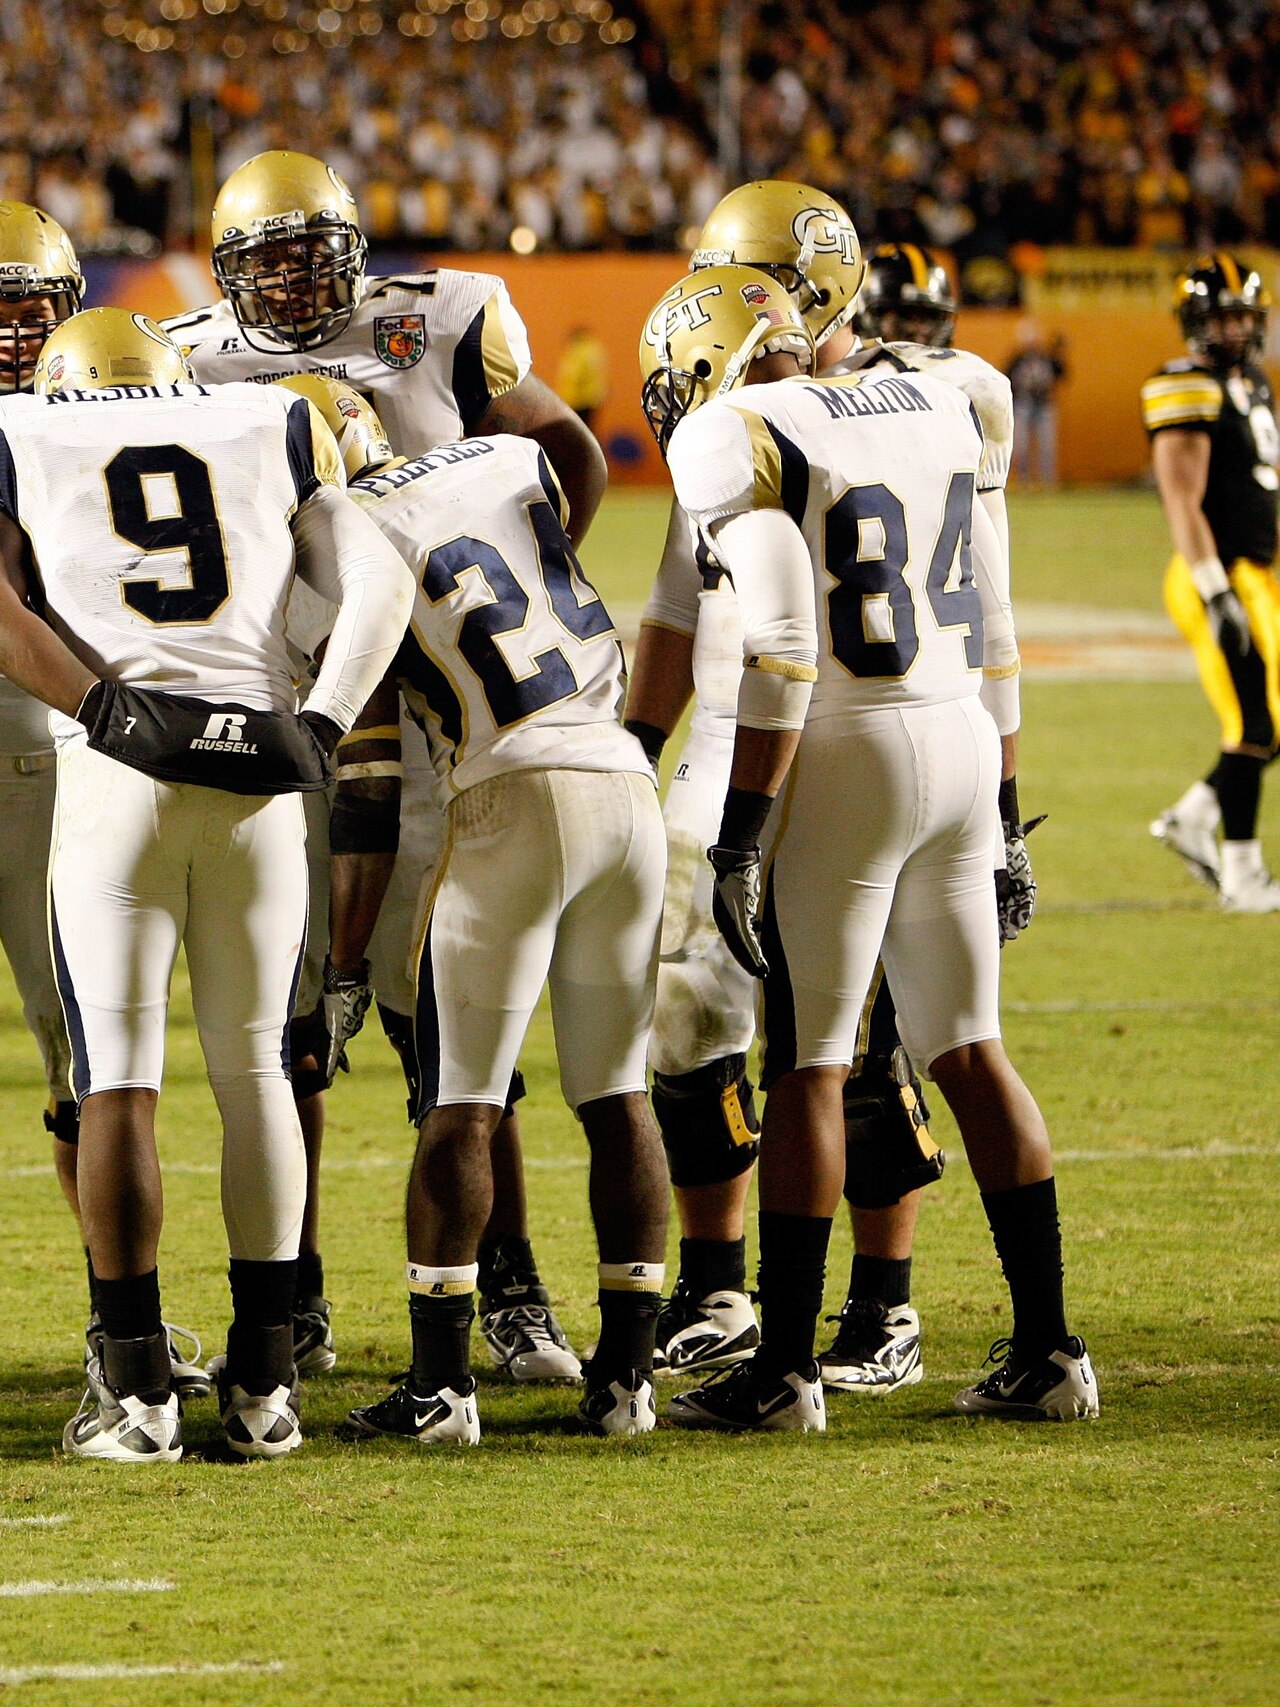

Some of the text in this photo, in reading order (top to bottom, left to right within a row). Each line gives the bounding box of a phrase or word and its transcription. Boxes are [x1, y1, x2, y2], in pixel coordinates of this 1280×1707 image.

[264, 215, 289, 228] ACC
[89, 366, 99, 379] 9
[803, 377, 933, 419] MELTON
[100, 441, 233, 629] 9
[824, 468, 984, 680] 84
[420, 500, 625, 734] 24
[123, 715, 137, 735] 7
[190, 738, 258, 754] RUSSELL
